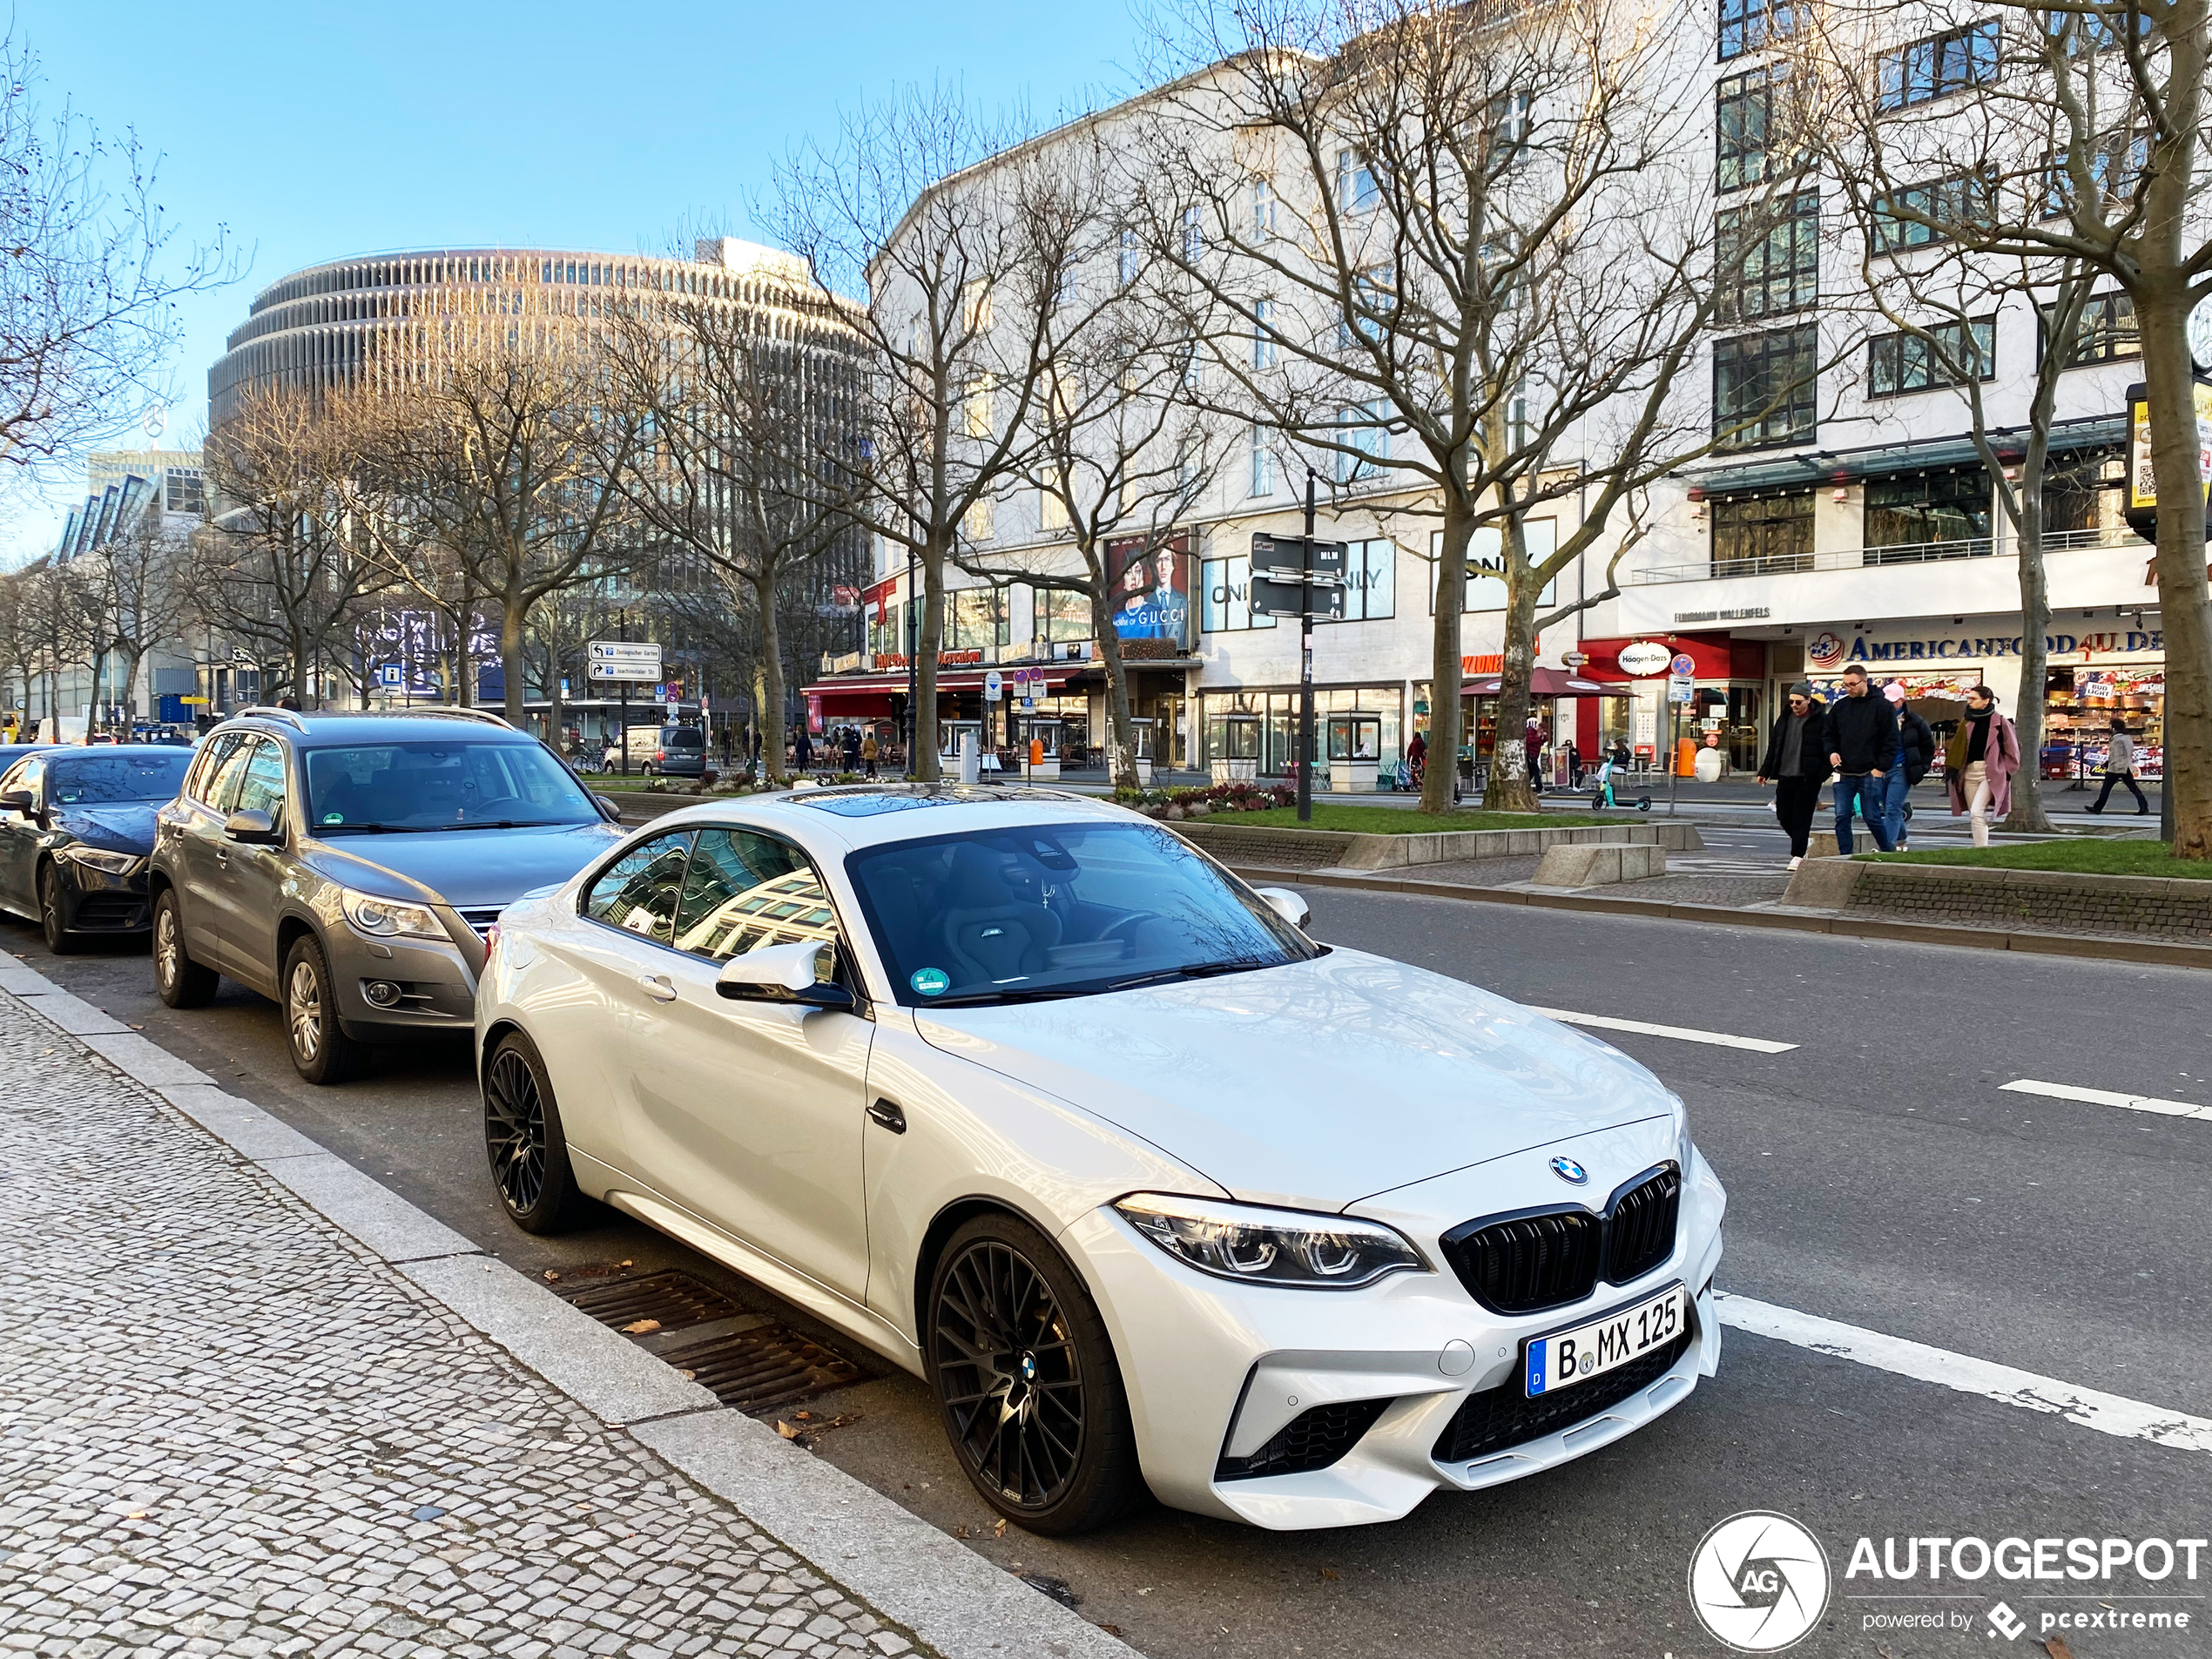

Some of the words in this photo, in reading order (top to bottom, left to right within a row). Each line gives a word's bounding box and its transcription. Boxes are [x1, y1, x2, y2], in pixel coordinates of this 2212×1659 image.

[1138, 608, 1184, 624] GUCCI
[1720, 607, 1770, 620] WALLENFELS
[1622, 654, 1667, 664] Häagen-Dazs
[925, 971, 934, 981] 4
[1559, 1339, 1576, 1380] B
[1598, 1318, 1630, 1367] MX
[1637, 1295, 1677, 1349] 125
[1534, 1372, 1541, 1385] D
